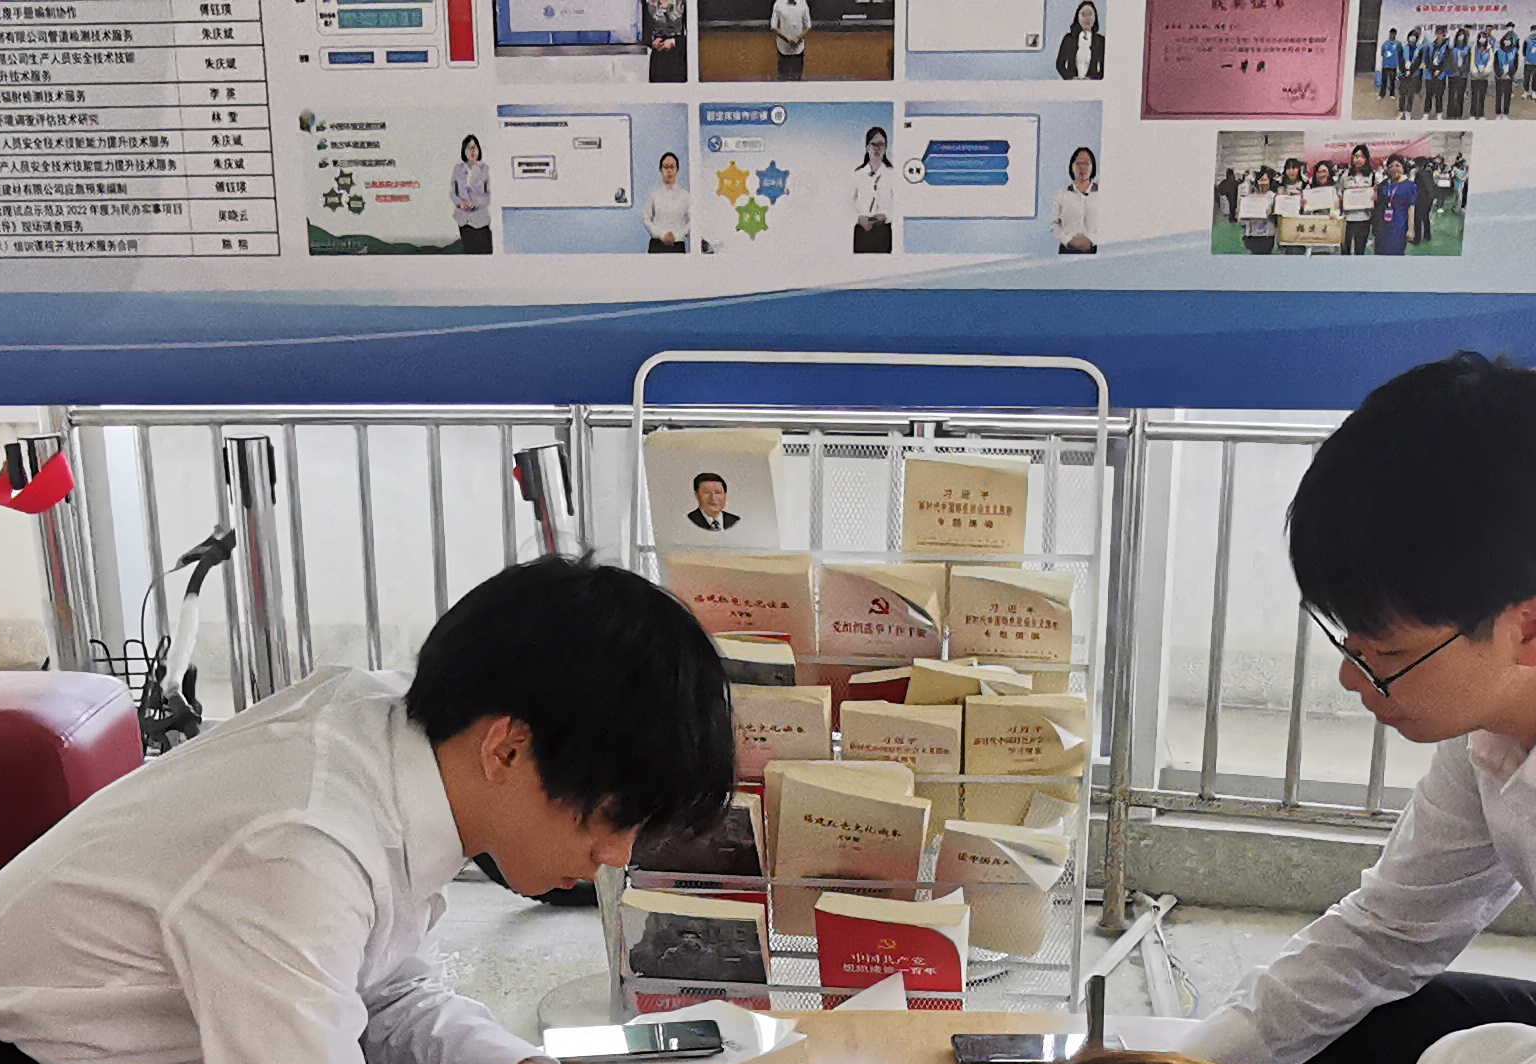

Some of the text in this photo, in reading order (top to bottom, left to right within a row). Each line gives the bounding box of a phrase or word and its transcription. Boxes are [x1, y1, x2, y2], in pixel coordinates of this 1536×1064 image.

[851, 952, 927, 966] 中国共产党
